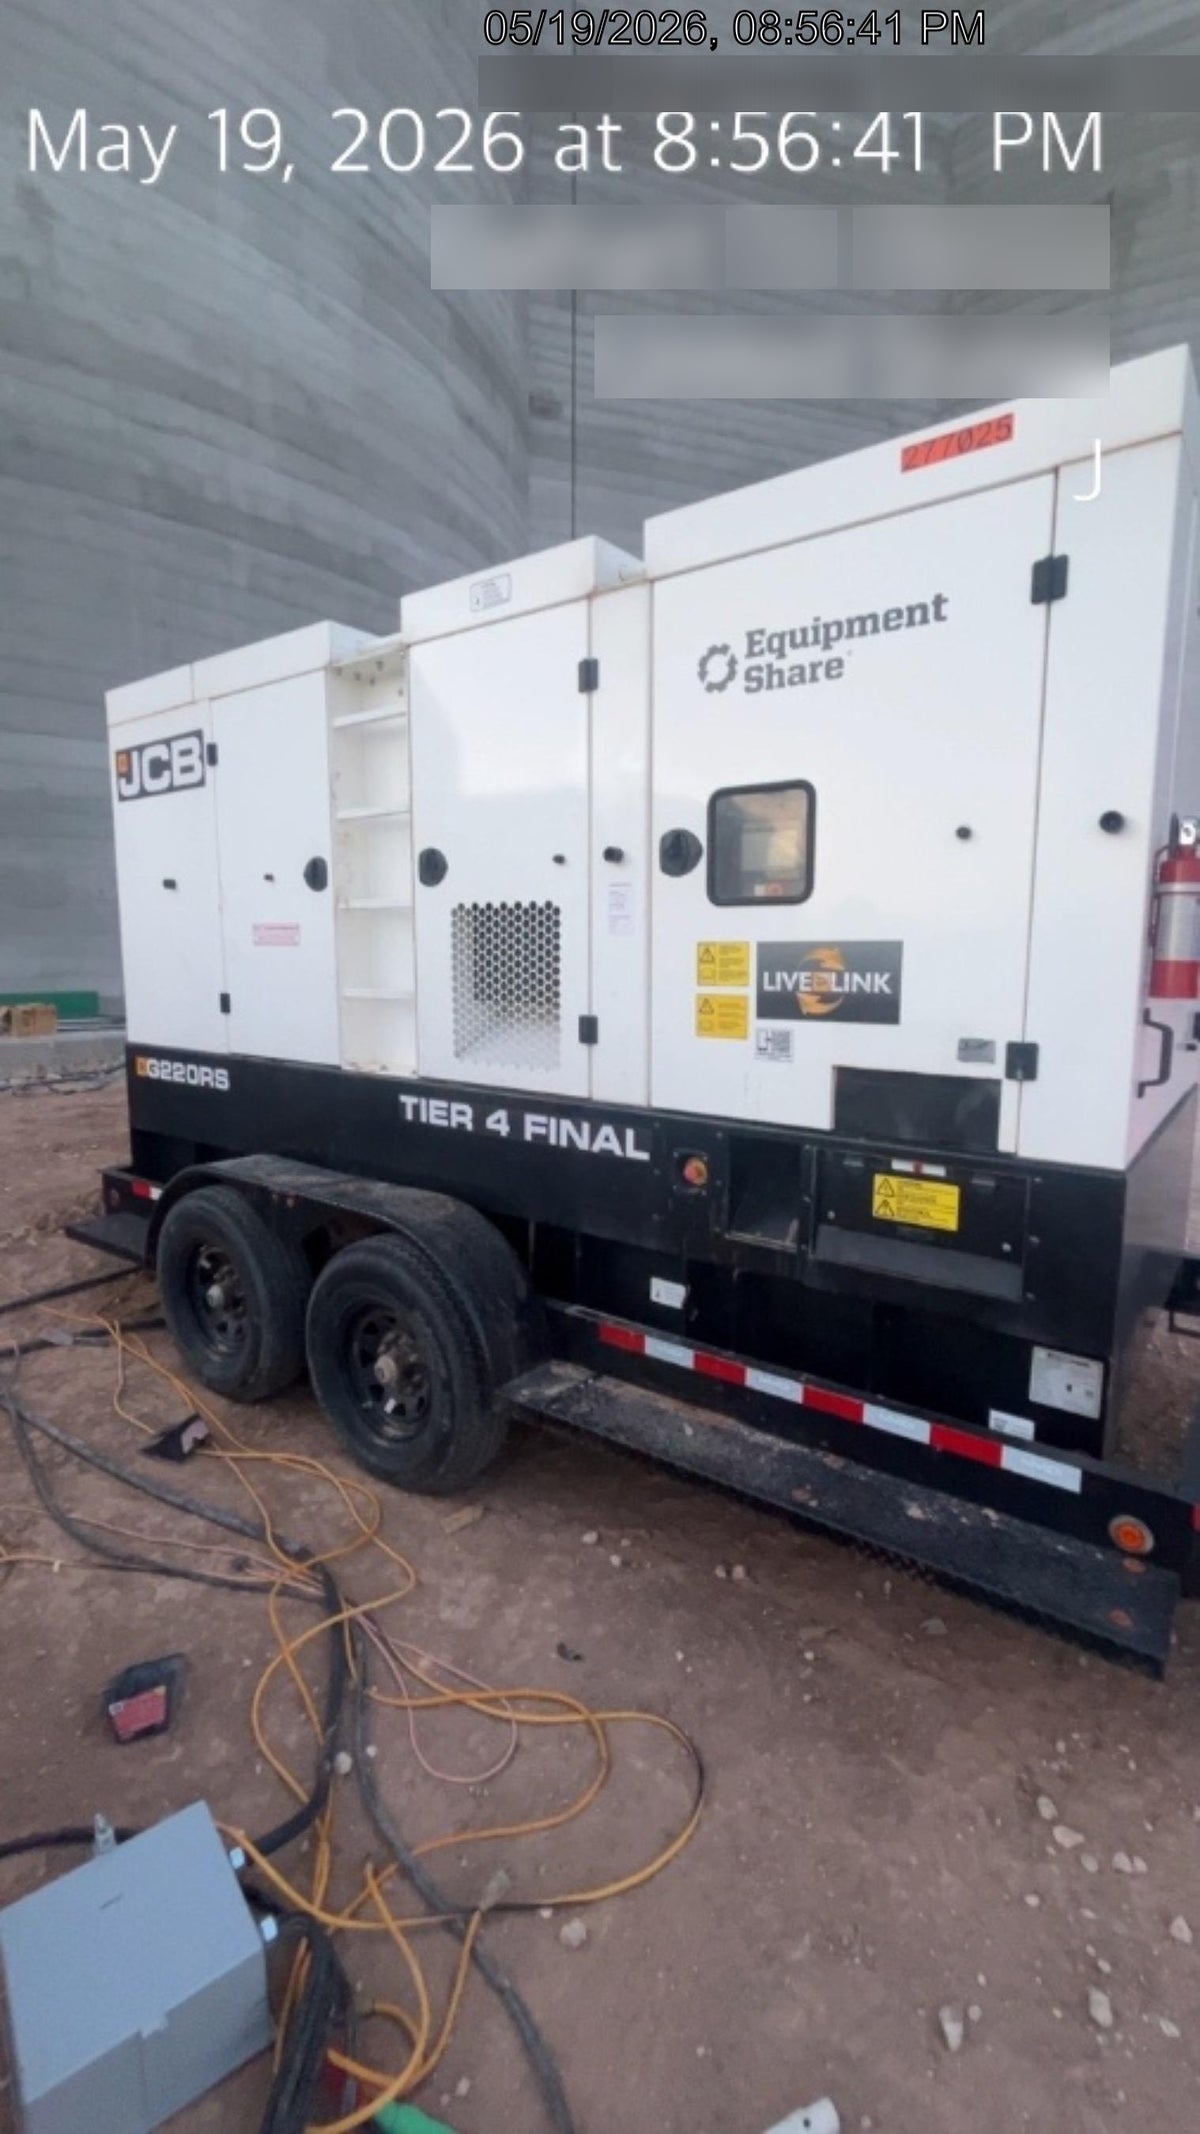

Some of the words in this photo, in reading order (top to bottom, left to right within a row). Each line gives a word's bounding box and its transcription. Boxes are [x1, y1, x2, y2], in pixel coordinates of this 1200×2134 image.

[902, 413, 1014, 472] 277025
[744, 592, 949, 660] Equipment
[743, 655, 845, 694] Share
[118, 735, 203, 798] JCB
[146, 1058, 230, 1092] G220RS
[399, 1094, 474, 1132] TIER
[485, 1109, 511, 1137] 4
[523, 1112, 650, 1162] FINAL
